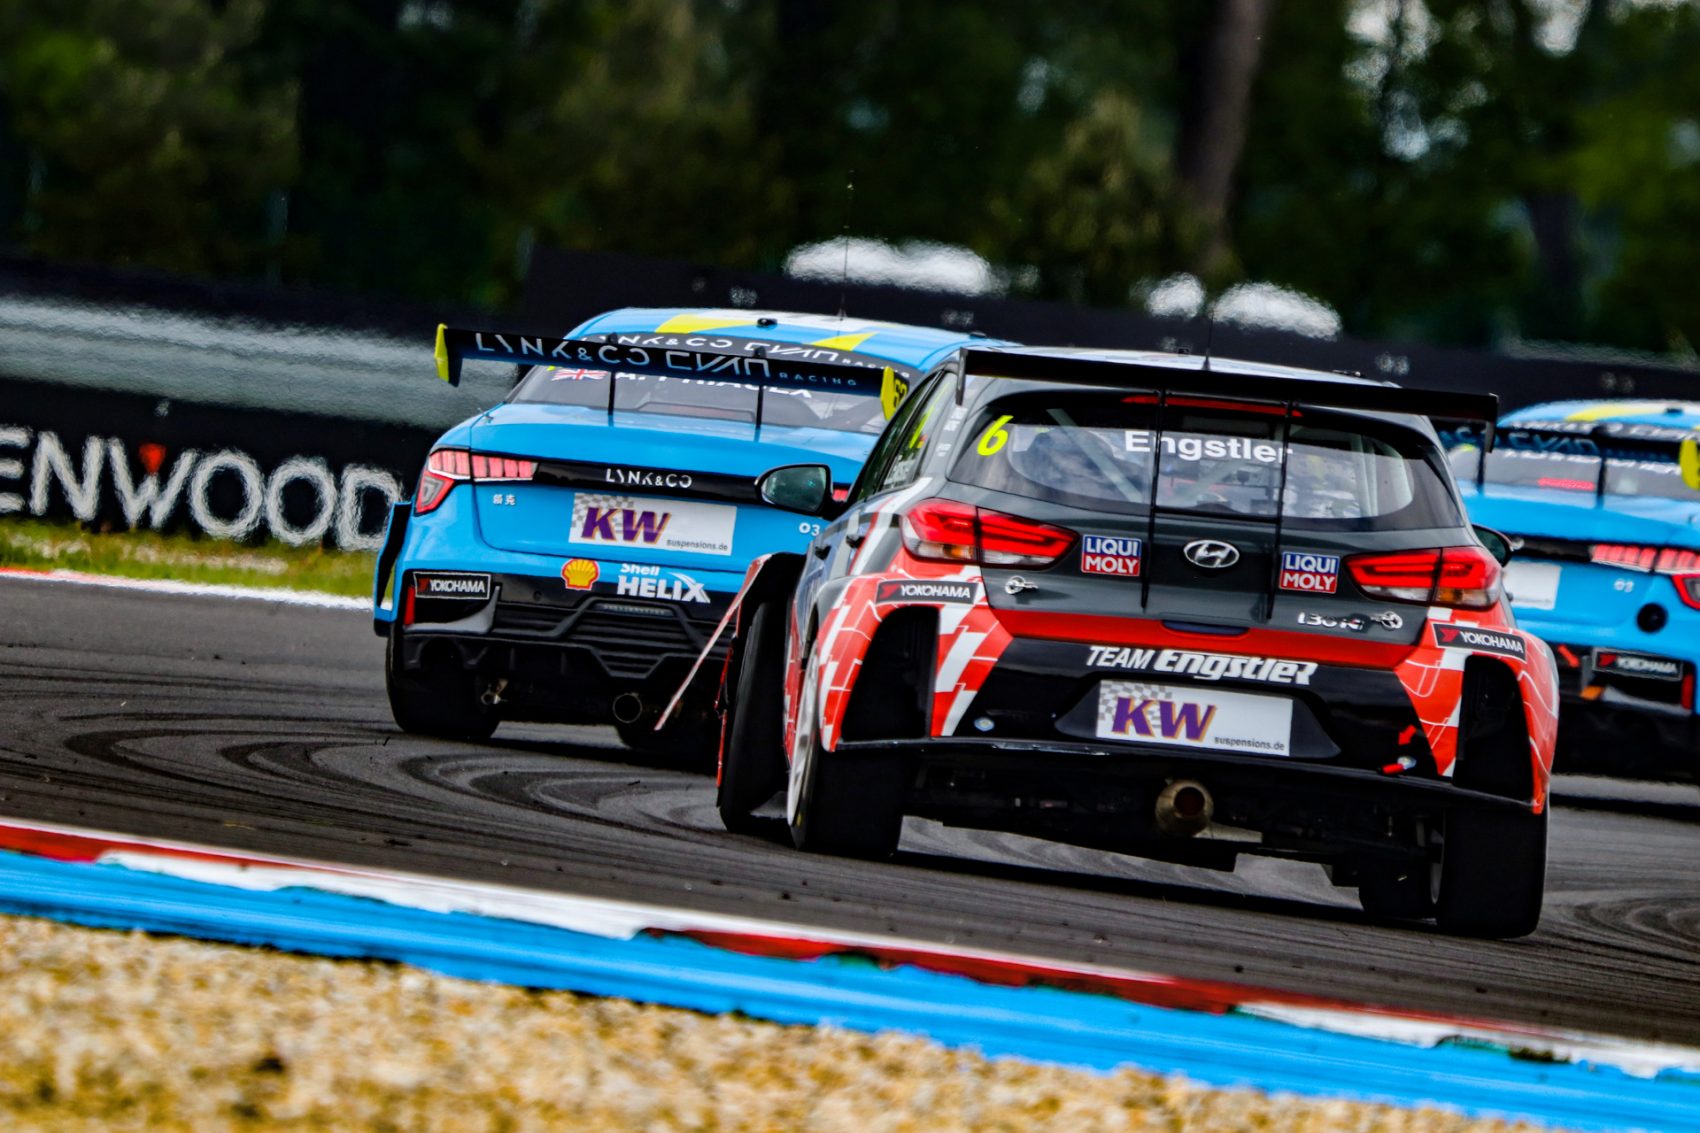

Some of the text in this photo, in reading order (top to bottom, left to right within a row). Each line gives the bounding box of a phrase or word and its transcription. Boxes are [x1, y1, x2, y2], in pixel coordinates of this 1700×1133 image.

[581, 335, 733, 348] NK&CO
[779, 372, 857, 386] RACING
[977, 414, 1014, 457] 6
[1125, 430, 1293, 463] Engstler
[581, 505, 673, 545] KW
[799, 522, 821, 537] 03
[666, 538, 728, 552] suspensions.de
[1085, 536, 1139, 557] LIQUI
[1083, 557, 1138, 576] MOLY
[1284, 553, 1337, 574] LIQUI
[430, 579, 486, 593] YOKOHAMA
[617, 571, 711, 604] HELIX
[900, 584, 971, 599] YOKOHAMA
[1283, 574, 1336, 592] MOLY
[1460, 631, 1524, 654] YOKOHAMA
[1086, 645, 1155, 670] TEAM
[1111, 695, 1217, 743] KW
[1213, 735, 1285, 751] suspensions.de
